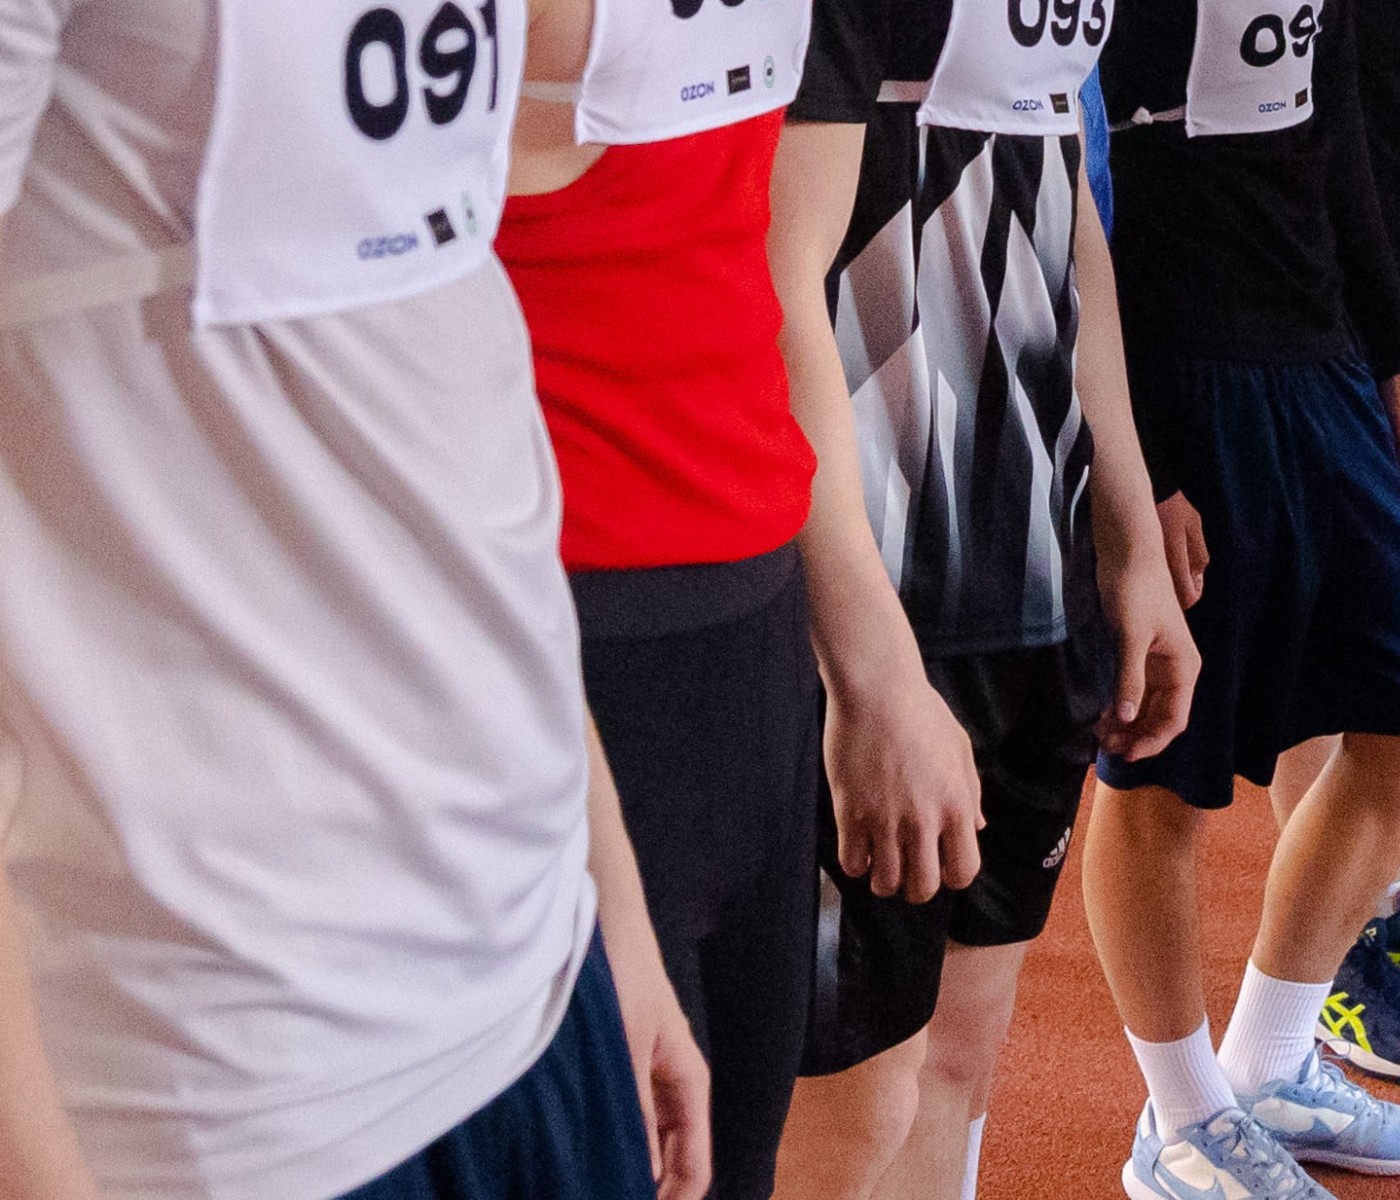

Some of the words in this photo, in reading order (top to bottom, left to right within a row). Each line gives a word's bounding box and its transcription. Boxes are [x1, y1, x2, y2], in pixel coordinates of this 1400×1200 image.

[1240, 3, 1317, 67] 09
[680, 80, 715, 102] OZON
[1012, 99, 1044, 111] OZON
[1258, 101, 1287, 114] OZON
